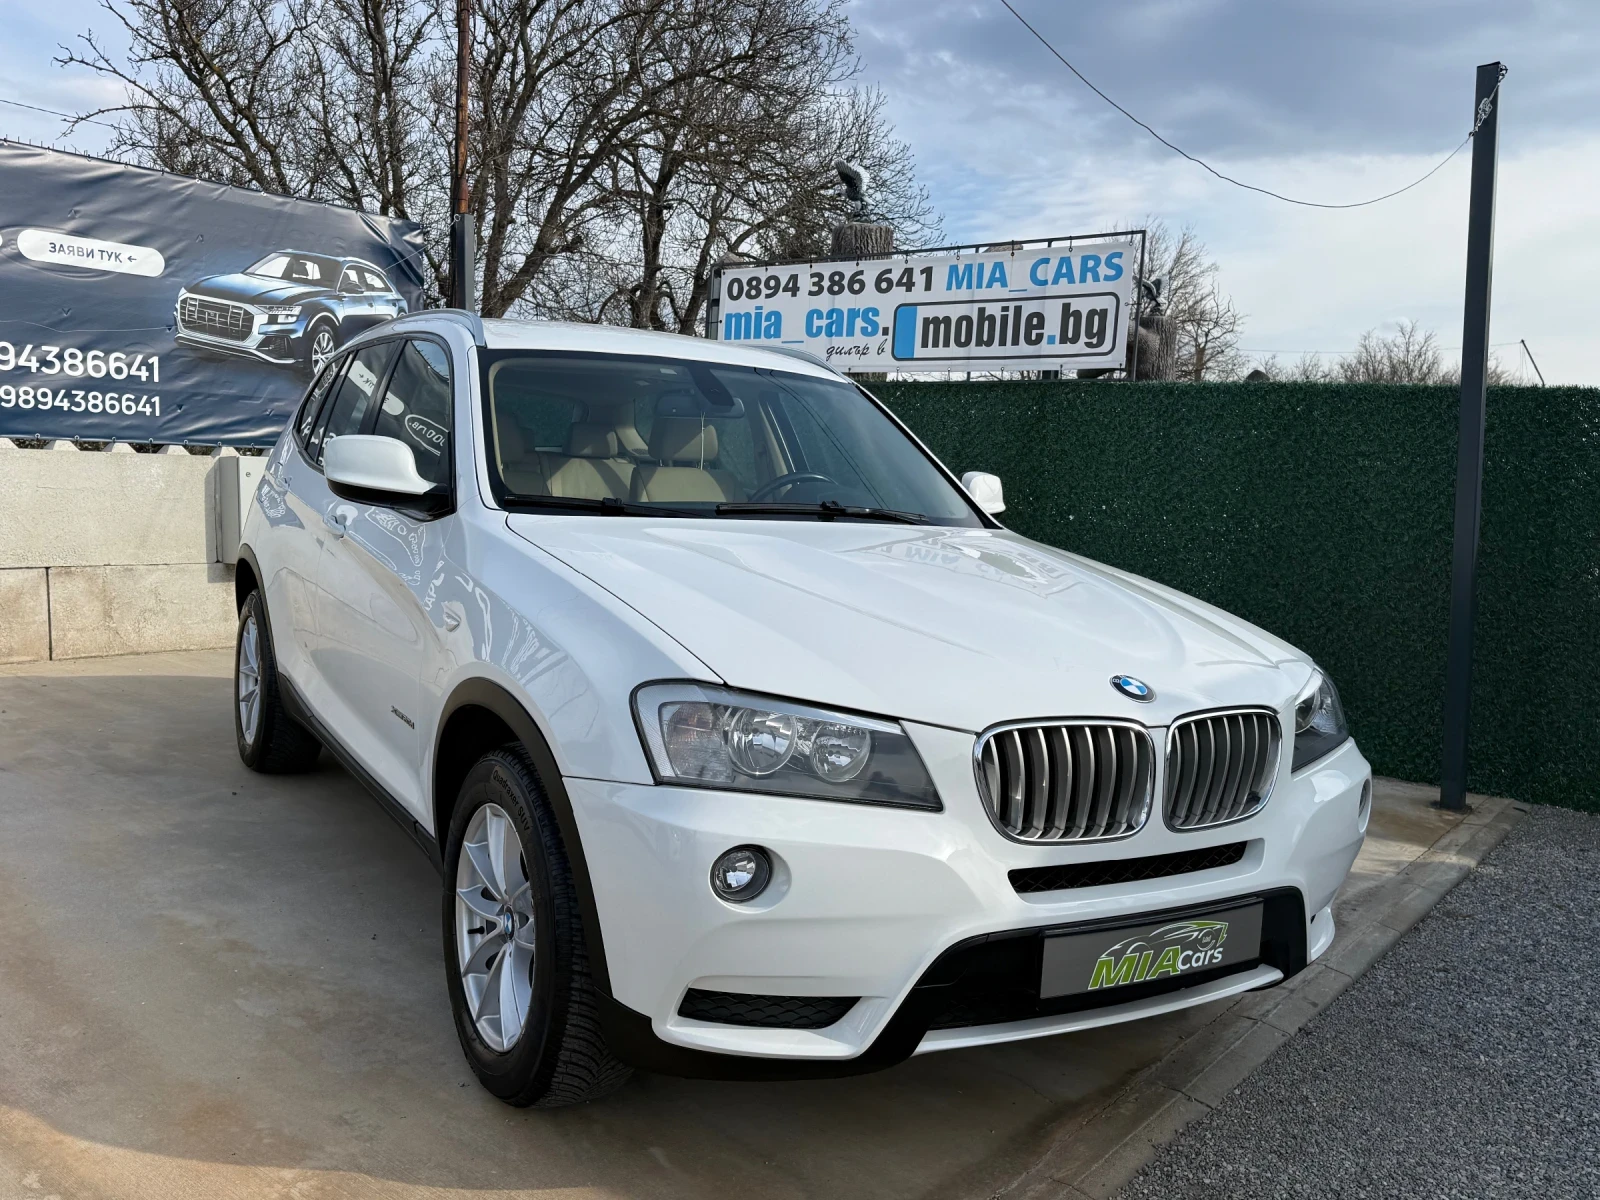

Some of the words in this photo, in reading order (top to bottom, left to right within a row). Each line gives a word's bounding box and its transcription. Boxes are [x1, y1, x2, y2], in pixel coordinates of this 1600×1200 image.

[48, 242, 94, 260] ЗАЯВИ
[98, 249, 122, 263] ТУК
[726, 273, 800, 301] 0894
[808, 270, 866, 297] 386
[874, 266, 934, 294] 641
[921, 302, 1109, 350] mobile.bg
[0, 341, 160, 382] 94386641
[0, 385, 161, 417] 9894386641
